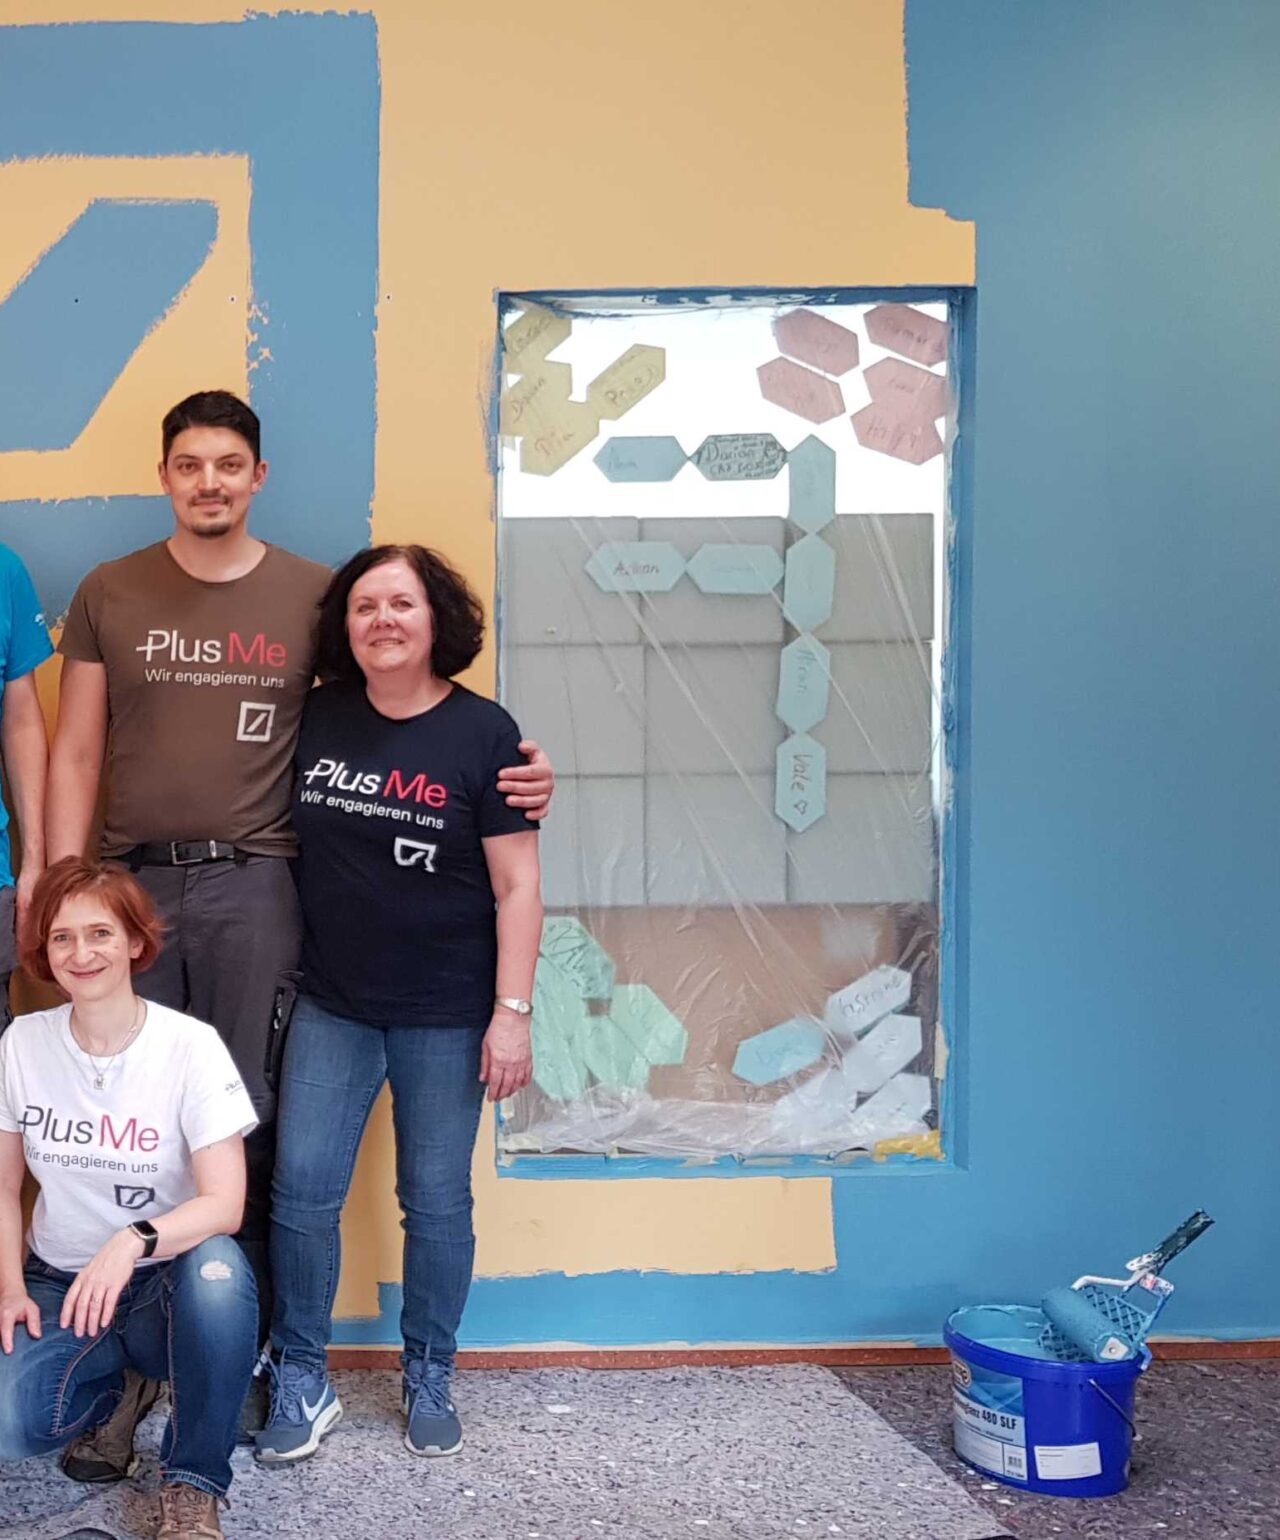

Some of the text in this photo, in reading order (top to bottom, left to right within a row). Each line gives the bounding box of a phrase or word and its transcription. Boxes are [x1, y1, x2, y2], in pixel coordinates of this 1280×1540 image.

[227, 631, 287, 667] Me
[145, 669, 285, 688] Wir engagieren uns
[383, 769, 447, 808] Me
[300, 790, 444, 829] Wir engagieren uns
[99, 1114, 160, 1152] Me
[42, 1152, 126, 1172] engagieren
[131, 1162, 159, 1173] uns
[982, 1409, 1017, 1430] 480 SLF
